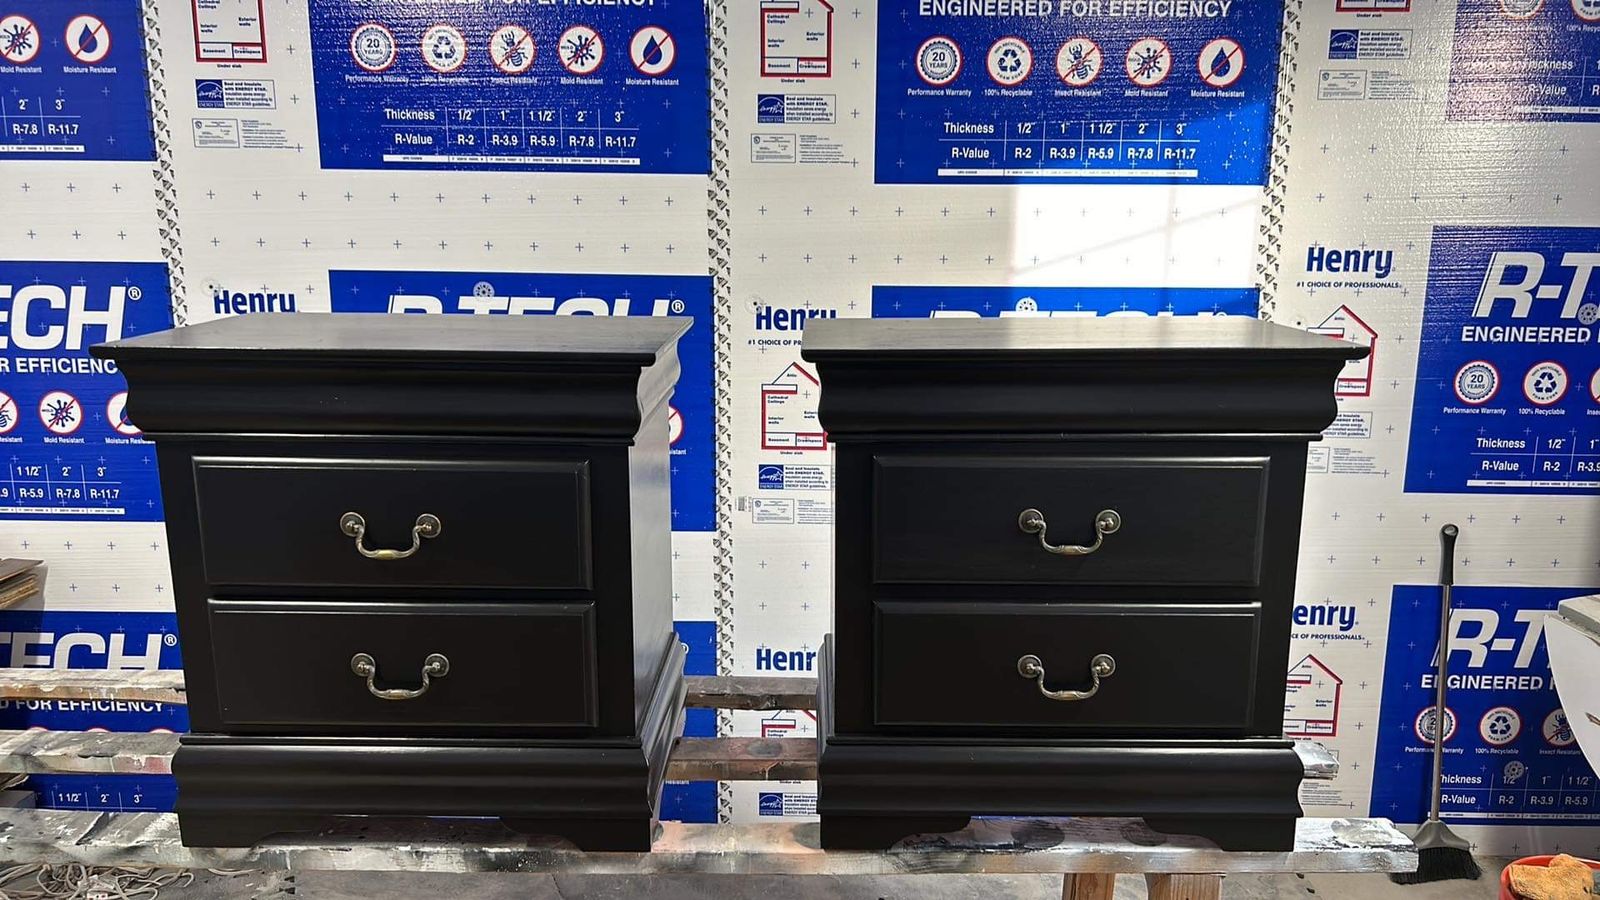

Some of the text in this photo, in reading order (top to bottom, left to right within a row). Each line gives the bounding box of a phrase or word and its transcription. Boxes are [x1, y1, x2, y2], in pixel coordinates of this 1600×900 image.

[919, 0, 1232, 18] ENGINEERED FOR EFFICIENCY
[367, 39, 380, 48] 20
[932, 52, 946, 61] 20
[576, 77, 604, 85] Resistant
[907, 88, 972, 97] Performance Warranty
[1001, 89, 1033, 97] Recyclable
[384, 108, 435, 120] Thickness
[13, 124, 79, 135] R-7.8 R-11.7
[944, 122, 994, 134] Thickness
[395, 133, 636, 147] R-Value R-2 R-3.9 R-5.9 R-7.8 R-11.7
[951, 147, 1196, 160] R-Value R-2 R-3.9 R-5.9 R-7.8 R-11.7
[1306, 246, 1393, 279] Henry
[1472, 252, 1600, 318] R-T
[1462, 327, 1591, 343] ENGINEERED
[15, 358, 118, 374] EFFICIENC
[1471, 374, 1484, 384] 20
[1481, 408, 1506, 416] Warranty
[1535, 408, 1565, 416] Recyclable
[1476, 438, 1525, 448] Thickness
[1482, 460, 1519, 471] R-Value
[1543, 461, 1560, 472] R-2
[20, 488, 119, 499] R-5.9 R-7.8 R-11.7
[1293, 604, 1355, 631] enry
[1430, 609, 1559, 668] R-T
[756, 648, 816, 671] Henr
[1441, 794, 1588, 806] R-Value R-2 R-3.9 R-5.9
